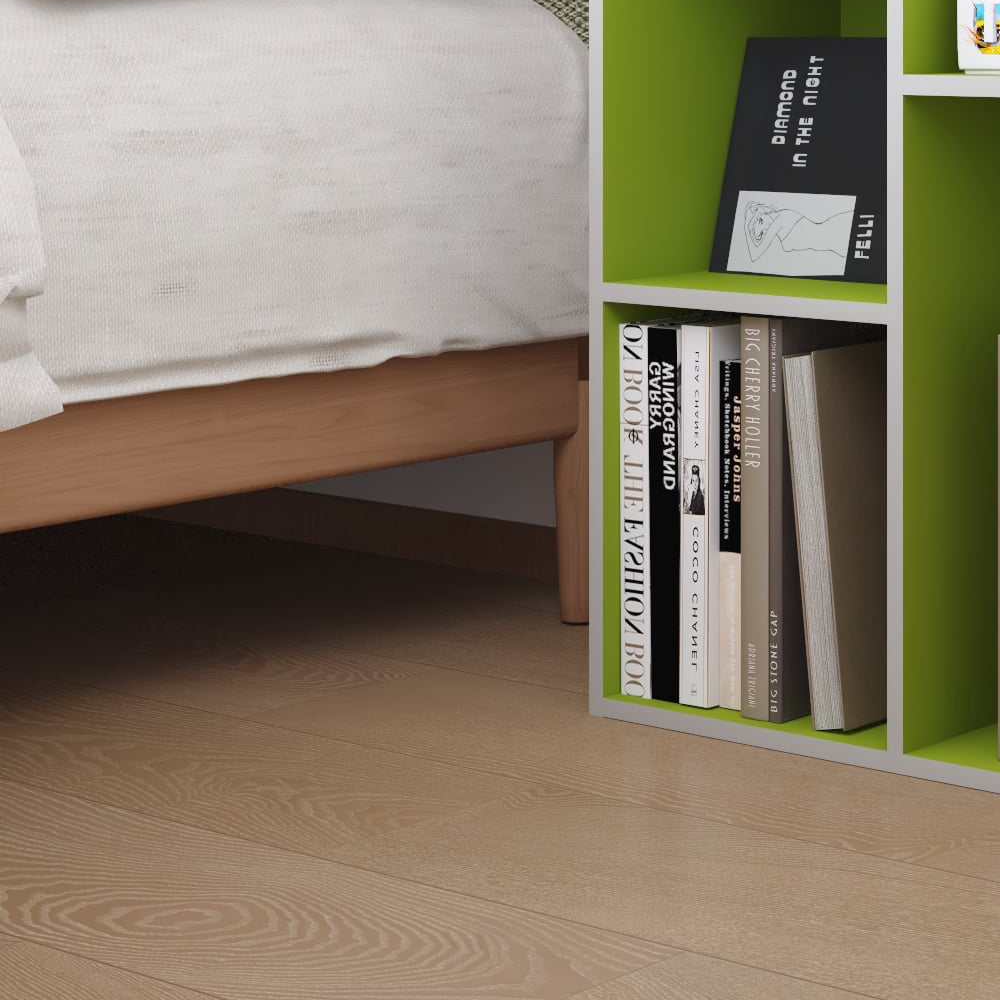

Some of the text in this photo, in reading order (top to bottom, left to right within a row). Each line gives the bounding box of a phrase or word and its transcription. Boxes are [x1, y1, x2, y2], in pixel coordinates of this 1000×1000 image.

[771, 69, 797, 145] DIAMOND
[802, 56, 825, 106] NIGHT
[795, 117, 814, 146] THE
[854, 214, 875, 260] FELLI
[744, 327, 761, 468] BIG CHERRY HOLLER
[731, 395, 742, 503] Jasper Johns
[769, 609, 778, 713] BIG STONE GAP
